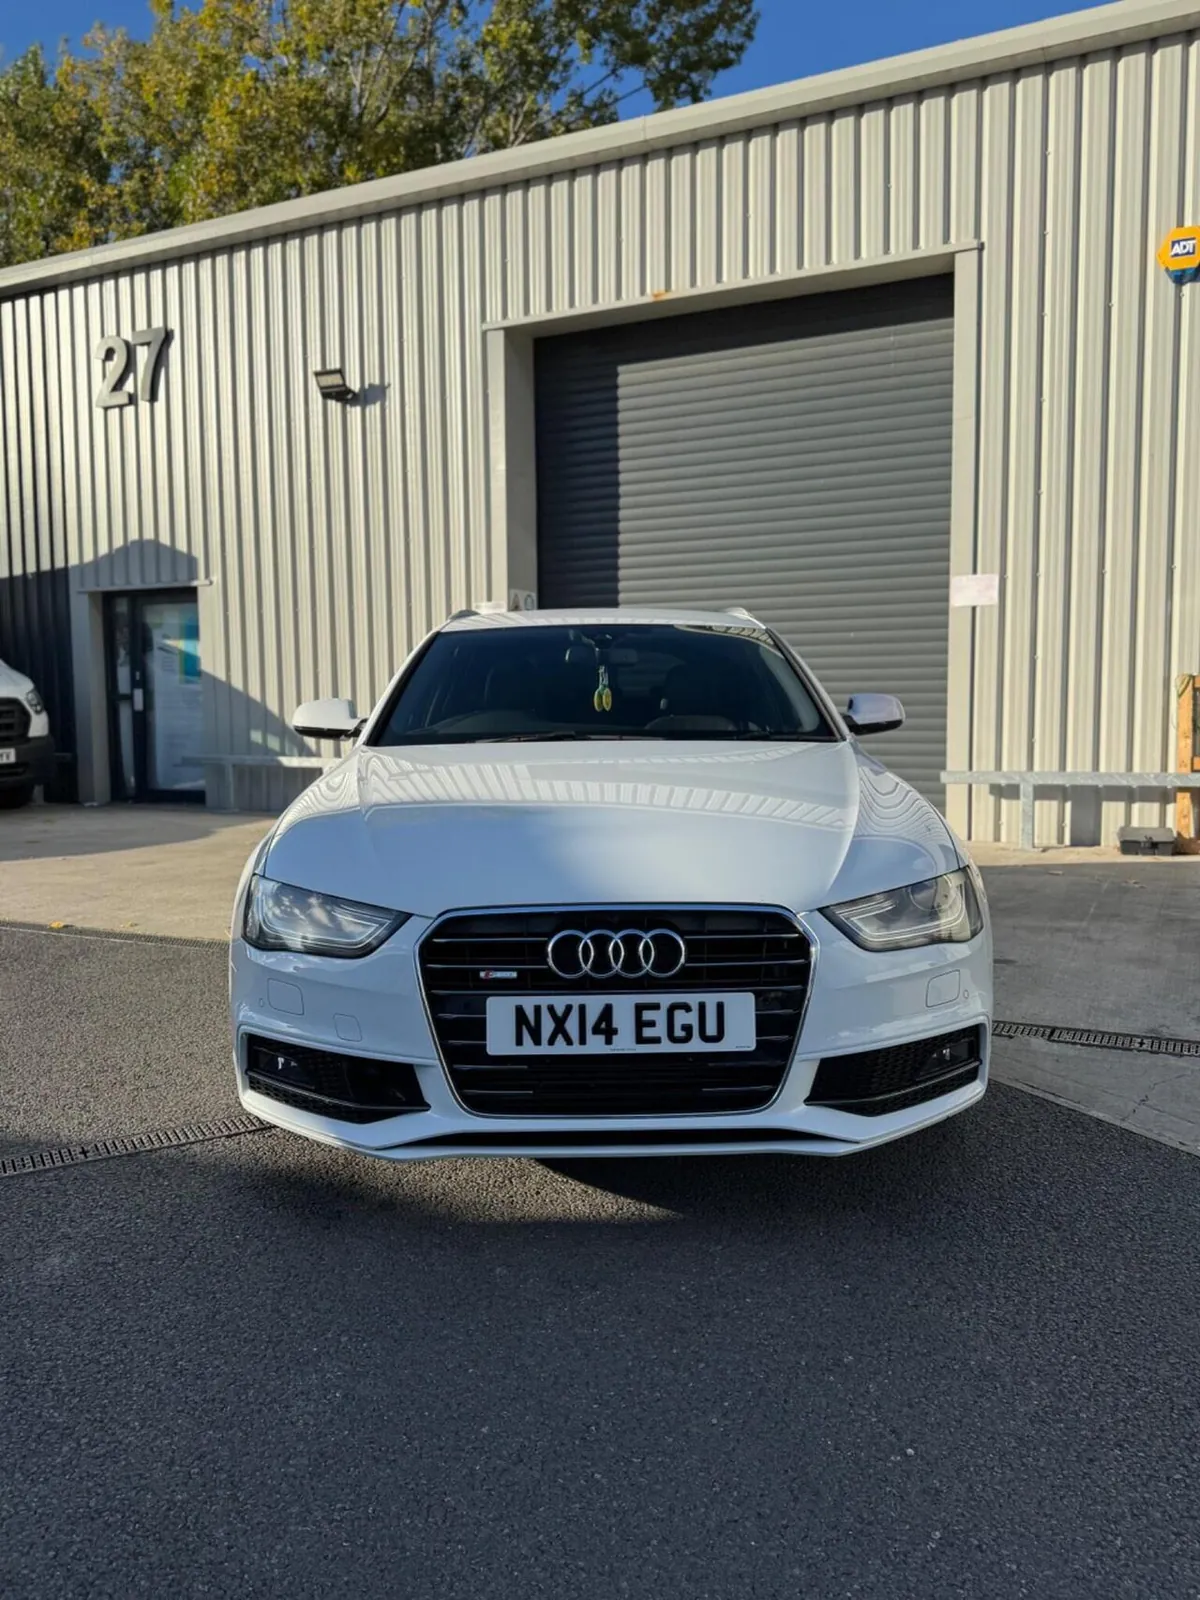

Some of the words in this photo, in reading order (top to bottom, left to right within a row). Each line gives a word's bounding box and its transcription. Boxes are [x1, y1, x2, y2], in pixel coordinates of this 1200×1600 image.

[1170, 240, 1196, 255] ADT
[94, 326, 168, 409] 27
[515, 1003, 618, 1046] NX14
[635, 1001, 725, 1045] EGU
